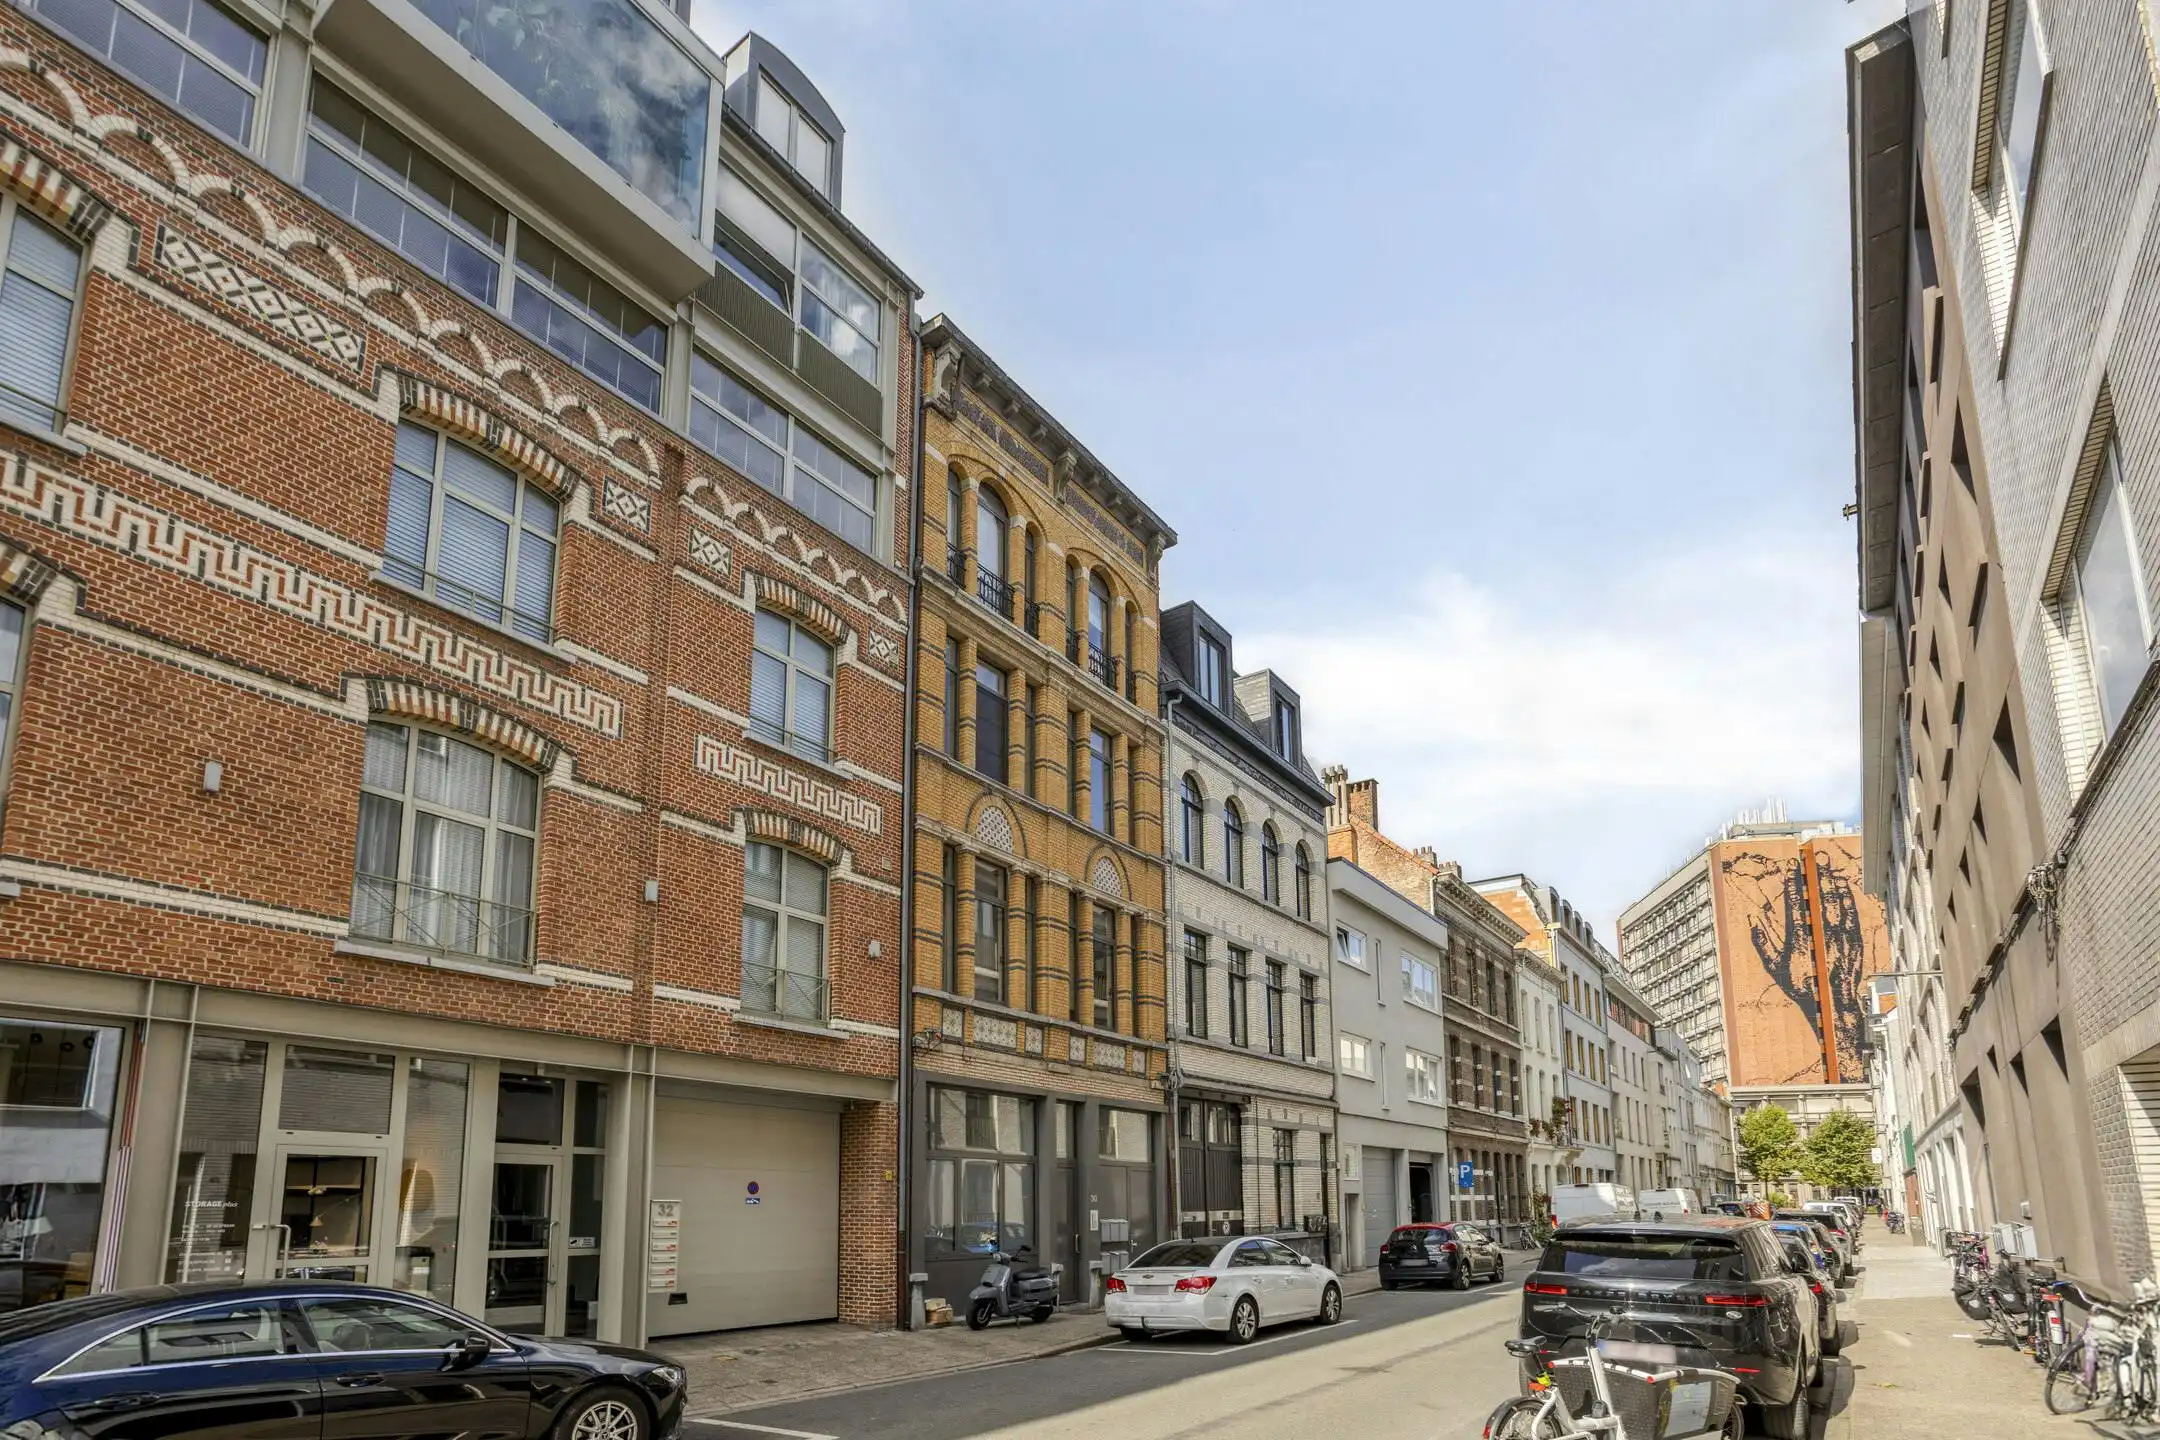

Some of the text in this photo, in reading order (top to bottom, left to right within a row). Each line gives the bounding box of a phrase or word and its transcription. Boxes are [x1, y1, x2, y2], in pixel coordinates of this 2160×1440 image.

[1460, 1165, 1470, 1178] P
[185, 1200, 222, 1208] STORAGE
[658, 1204, 673, 1217] 32
